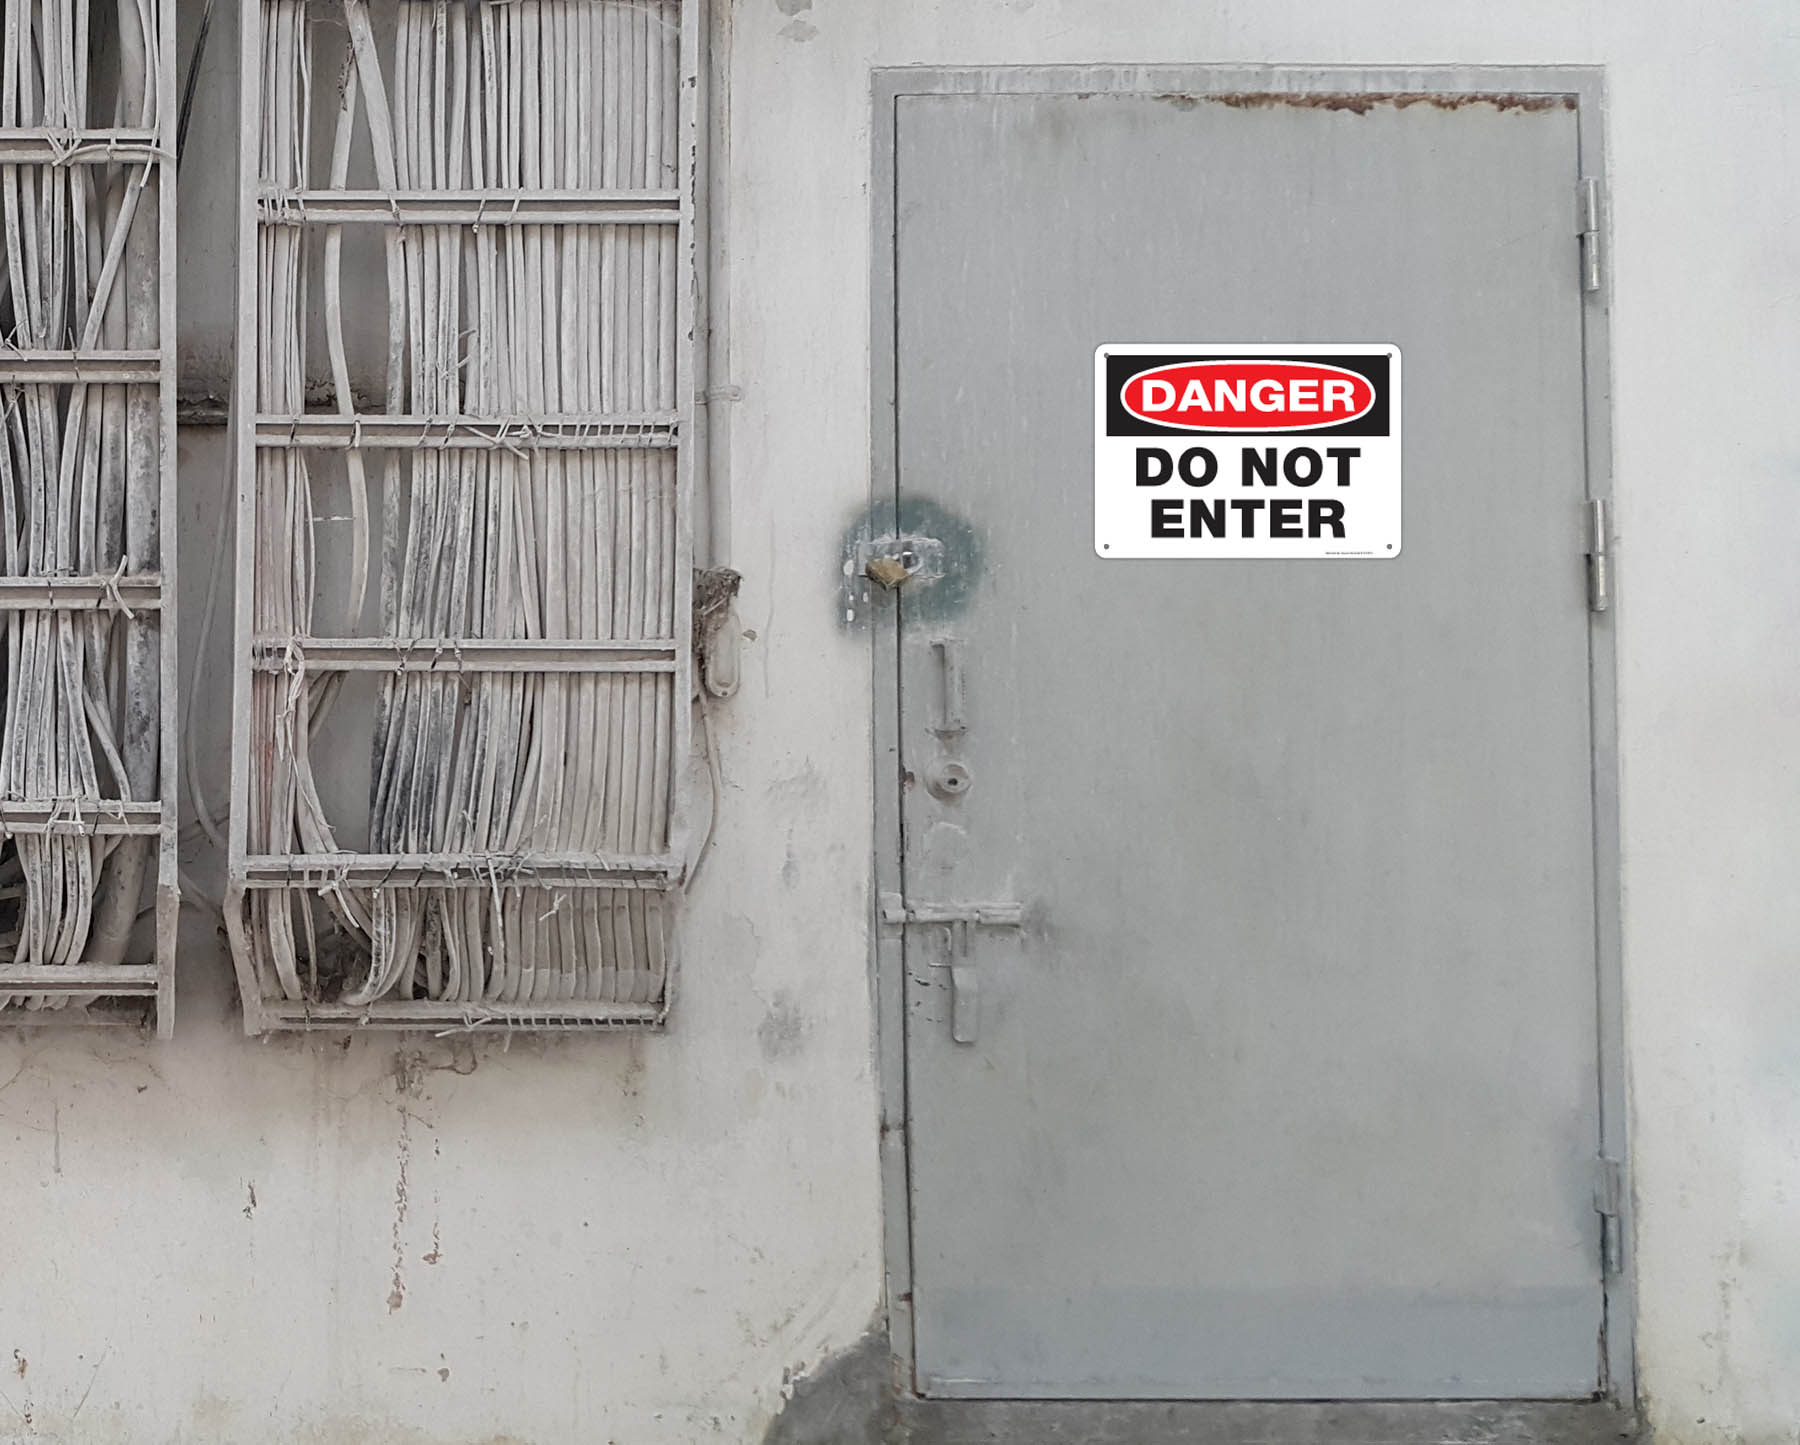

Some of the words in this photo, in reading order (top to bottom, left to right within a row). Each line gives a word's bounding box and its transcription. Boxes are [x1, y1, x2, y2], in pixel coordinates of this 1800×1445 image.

[1142, 379, 1356, 412] DANGER
[1136, 447, 1218, 487] DO
[1242, 447, 1361, 487] NOT
[1151, 499, 1346, 538] ENTER
